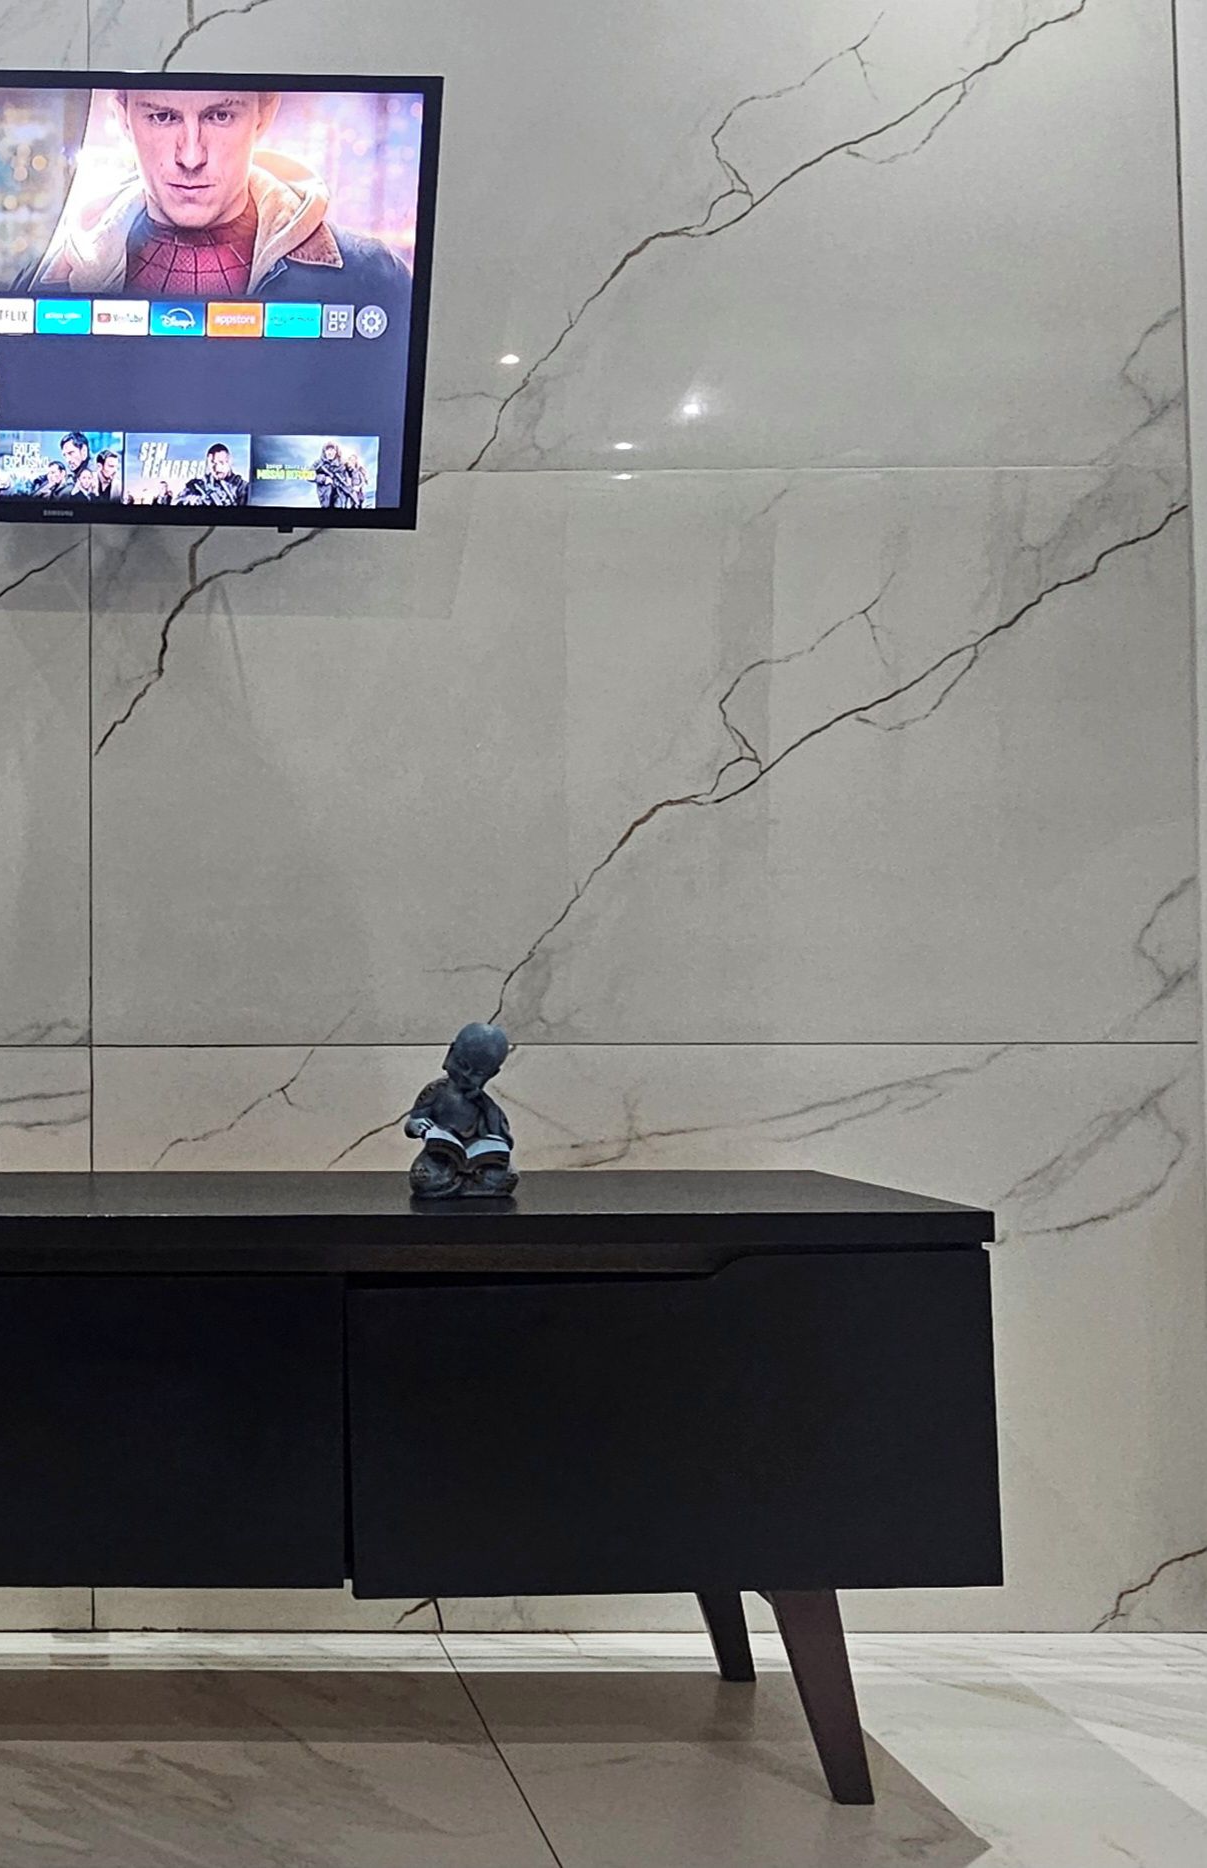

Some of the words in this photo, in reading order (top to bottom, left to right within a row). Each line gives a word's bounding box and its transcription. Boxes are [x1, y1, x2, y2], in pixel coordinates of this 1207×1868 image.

[213, 314, 257, 327] appstore
[138, 442, 170, 461] SEM
[141, 460, 206, 478] REMORSO
